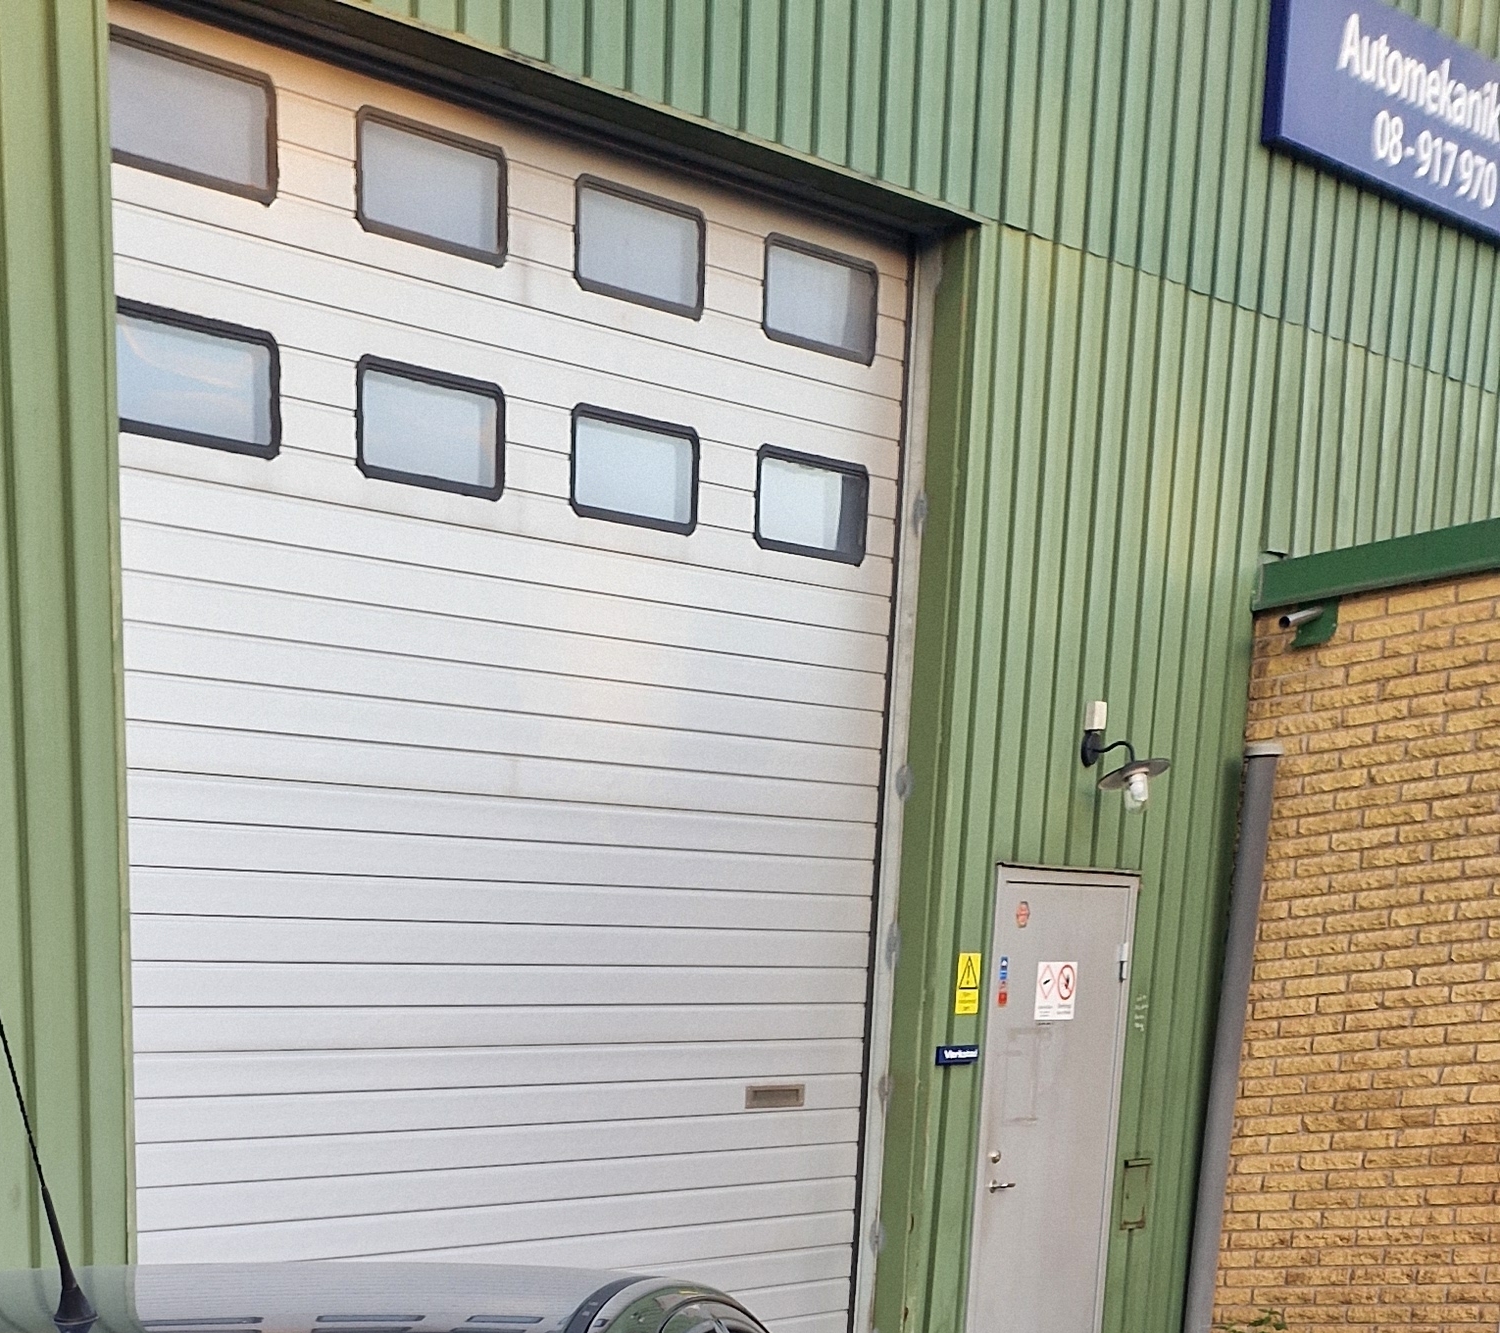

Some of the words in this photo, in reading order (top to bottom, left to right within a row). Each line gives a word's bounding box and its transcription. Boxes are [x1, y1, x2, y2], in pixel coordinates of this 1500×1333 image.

[1337, 13, 1500, 143] Automekanik
[1373, 110, 1458, 188] 08-917
[1455, 150, 1498, 209] 970
